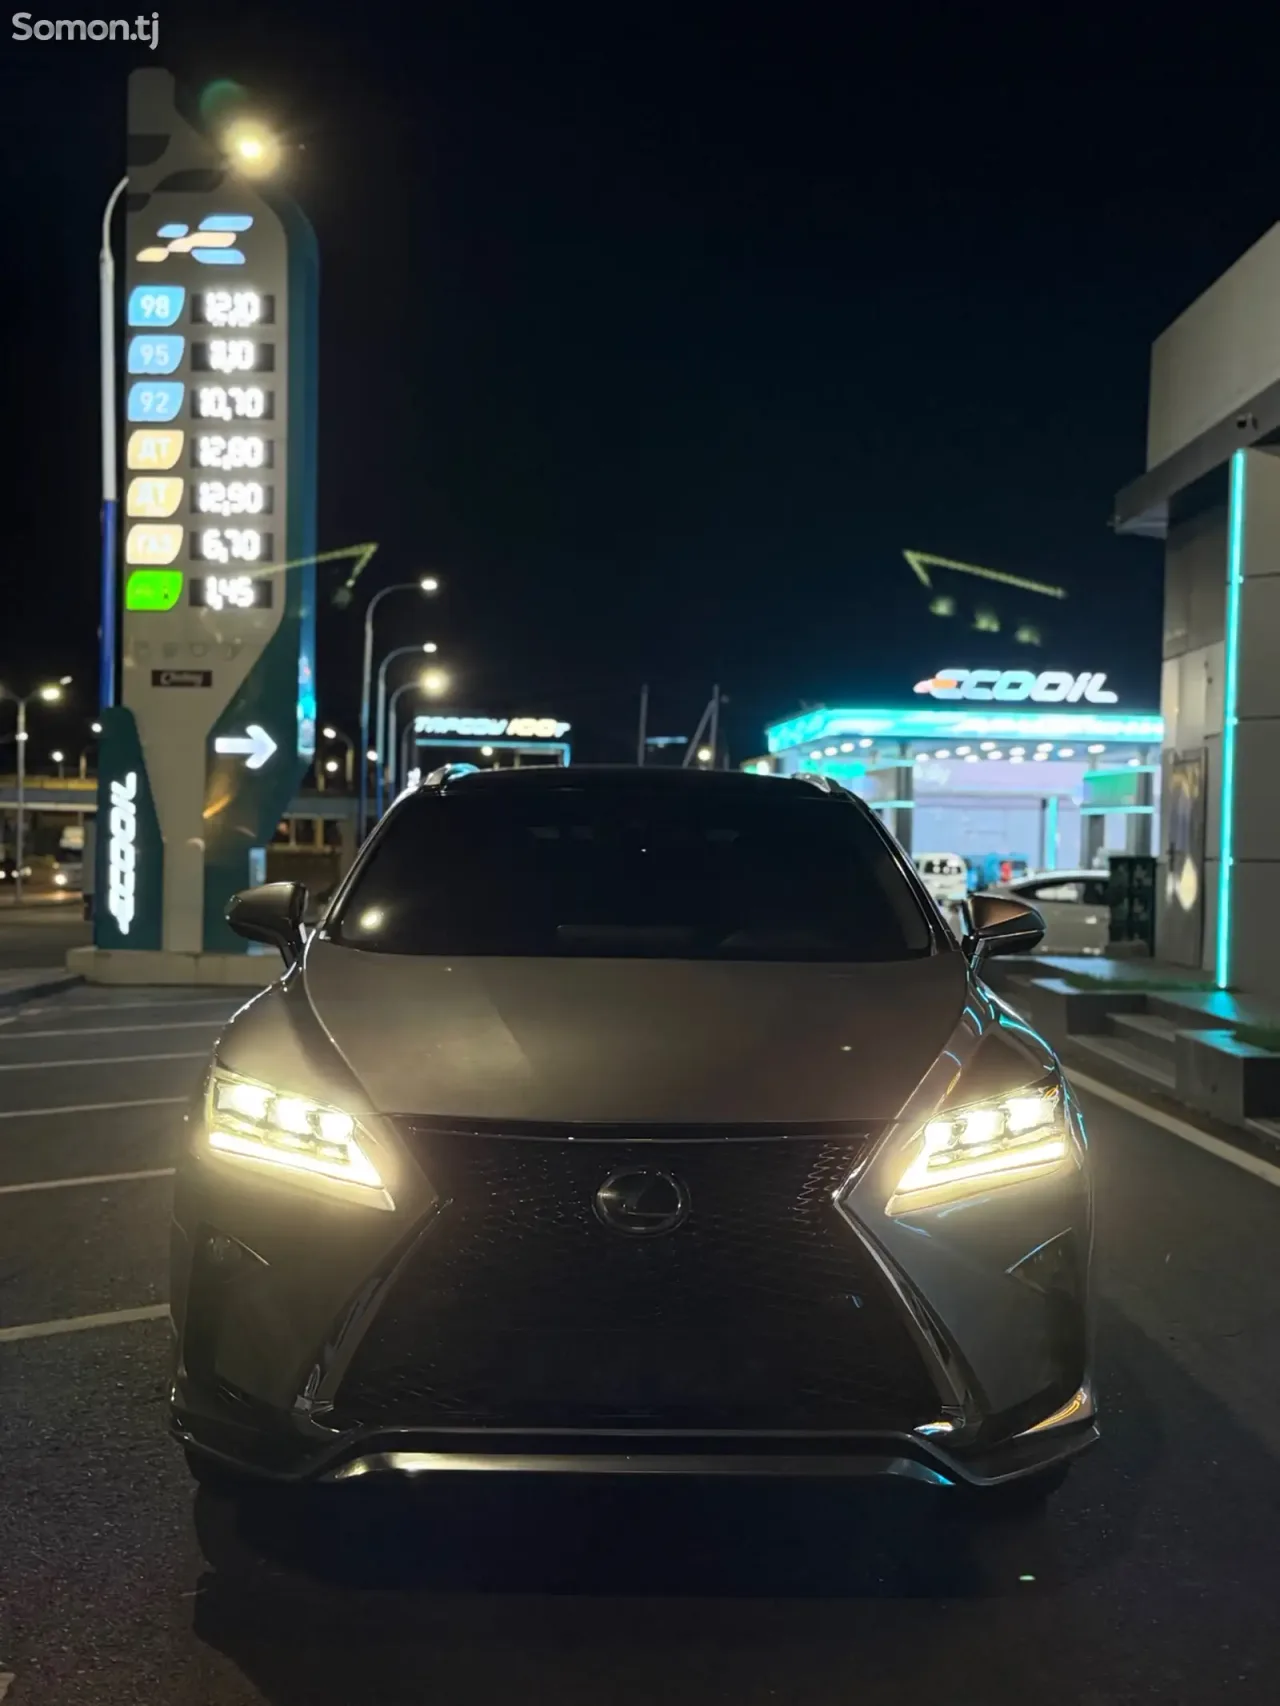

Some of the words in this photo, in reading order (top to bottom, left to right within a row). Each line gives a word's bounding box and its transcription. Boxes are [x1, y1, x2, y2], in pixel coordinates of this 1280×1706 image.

[140, 295, 170, 317] 98
[140, 344, 169, 366] 95
[140, 391, 169, 413] 92
[200, 387, 264, 421] 10,70
[202, 529, 261, 563] 6,70
[206, 576, 254, 610] 1,45
